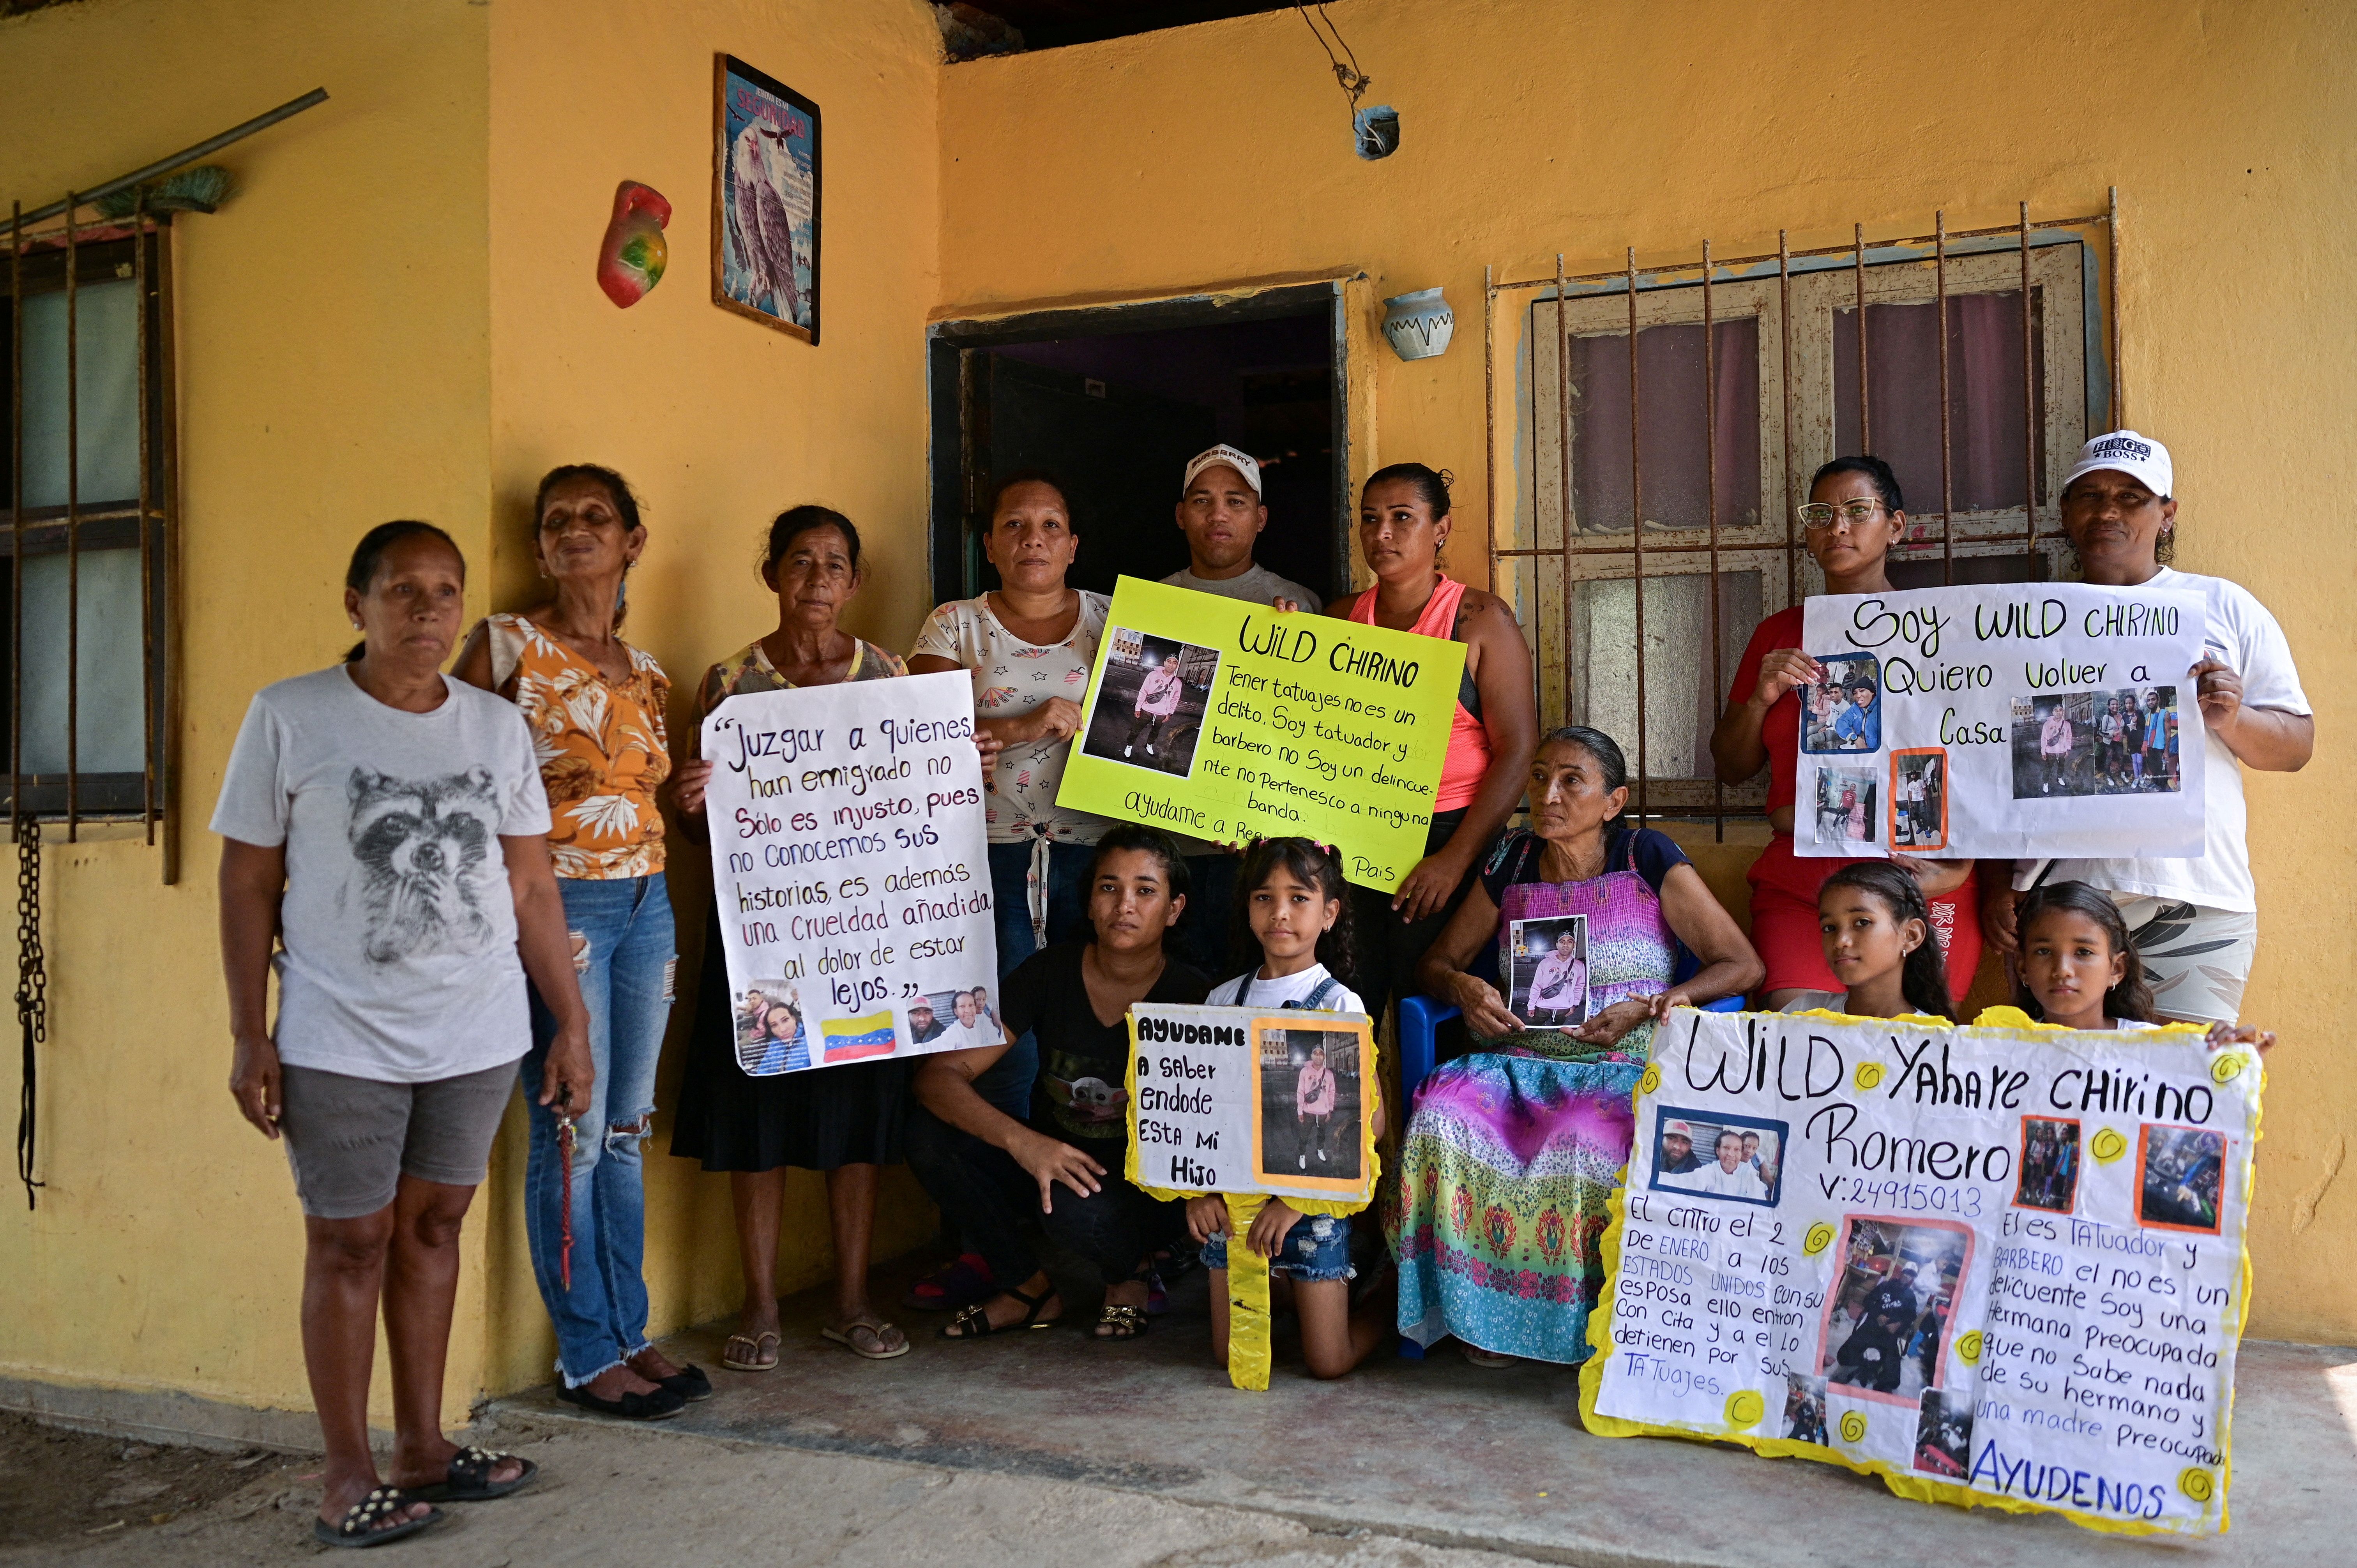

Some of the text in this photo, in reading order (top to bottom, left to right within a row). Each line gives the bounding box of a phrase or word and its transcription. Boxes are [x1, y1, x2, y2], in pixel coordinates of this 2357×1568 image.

[737, 88, 805, 139] SEGURIDAD
[776, 97, 781, 107] ES
[782, 101, 788, 111] MI
[1192, 449, 1251, 468] BURBERRY
[2094, 438, 2151, 457] HUGO
[2103, 450, 2138, 461] BOSS
[1845, 599, 2179, 659] Soy WILD CHIRINO
[1011, 648, 1051, 657] CIRCUS
[1329, 643, 1419, 688] CHIRINO
[1226, 664, 1415, 726] Tener tatuajes no es un
[1883, 656, 1993, 696] Quiero
[2130, 665, 2151, 682] a
[977, 687, 1018, 708] CIRCUS
[849, 727, 867, 750] a
[880, 717, 971, 754] quienes
[1272, 705, 1306, 738] Soy
[1313, 720, 1391, 753] tatuador
[1392, 744, 1408, 762] y
[1939, 707, 2007, 747] Casa
[1212, 726, 1272, 755] barbero
[1278, 747, 1299, 765] no
[1305, 749, 1337, 781] Soy
[1342, 765, 1366, 778] un
[747, 756, 951, 800] han emigrado no
[1203, 759, 1429, 829] nte no Pertenesco a ninguna
[790, 812, 818, 832] es
[926, 788, 979, 818] pues
[1125, 791, 1205, 829] ayudame
[1213, 819, 1225, 834] a
[729, 852, 753, 874] no
[839, 876, 869, 899] es
[885, 863, 970, 893] además
[1352, 856, 1395, 881] Pais
[742, 922, 780, 946] una
[903, 890, 993, 925] añadida
[784, 936, 965, 980] al dolor de estar
[1137, 1017, 1246, 1047] AYUDAME
[1137, 1056, 1149, 1077] A
[1140, 1082, 1212, 1115] endode
[1195, 1131, 1219, 1150] Mi
[1805, 1102, 2011, 1182] Romero
[1631, 1194, 1653, 1222] El
[1730, 1211, 1754, 1237] el
[1769, 1222, 1785, 1245] 2
[1627, 1229, 1653, 1250] De
[1659, 1236, 1709, 1261] ENERO
[1728, 1252, 1741, 1268] a
[2003, 1211, 2020, 1236] El
[2026, 1219, 2057, 1240] es
[2183, 1243, 2197, 1270] y
[1623, 1255, 1693, 1285] ESTADOS
[1711, 1273, 1765, 1298] UNIDOS
[1993, 1247, 2229, 1306] BARBERO el no es un
[1707, 1298, 1741, 1318] ello
[1986, 1300, 2071, 1339] Hermana
[1989, 1269, 2206, 1335] delicuente Soy una
[1615, 1323, 1695, 1358] detienen
[1706, 1323, 1719, 1343] y
[1733, 1330, 1745, 1344] a
[1755, 1332, 1772, 1348] el
[1983, 1331, 2024, 1358] que
[2031, 1347, 2057, 1365] no
[2145, 1373, 2204, 1402] nada
[1976, 1398, 2009, 1420] una
[2023, 1409, 2102, 1436] madre
[1981, 1358, 2006, 1384] de
[2064, 1376, 2180, 1423] hermano
[2192, 1414, 2203, 1439] y
[1968, 1438, 2166, 1520] AYUDENOS
